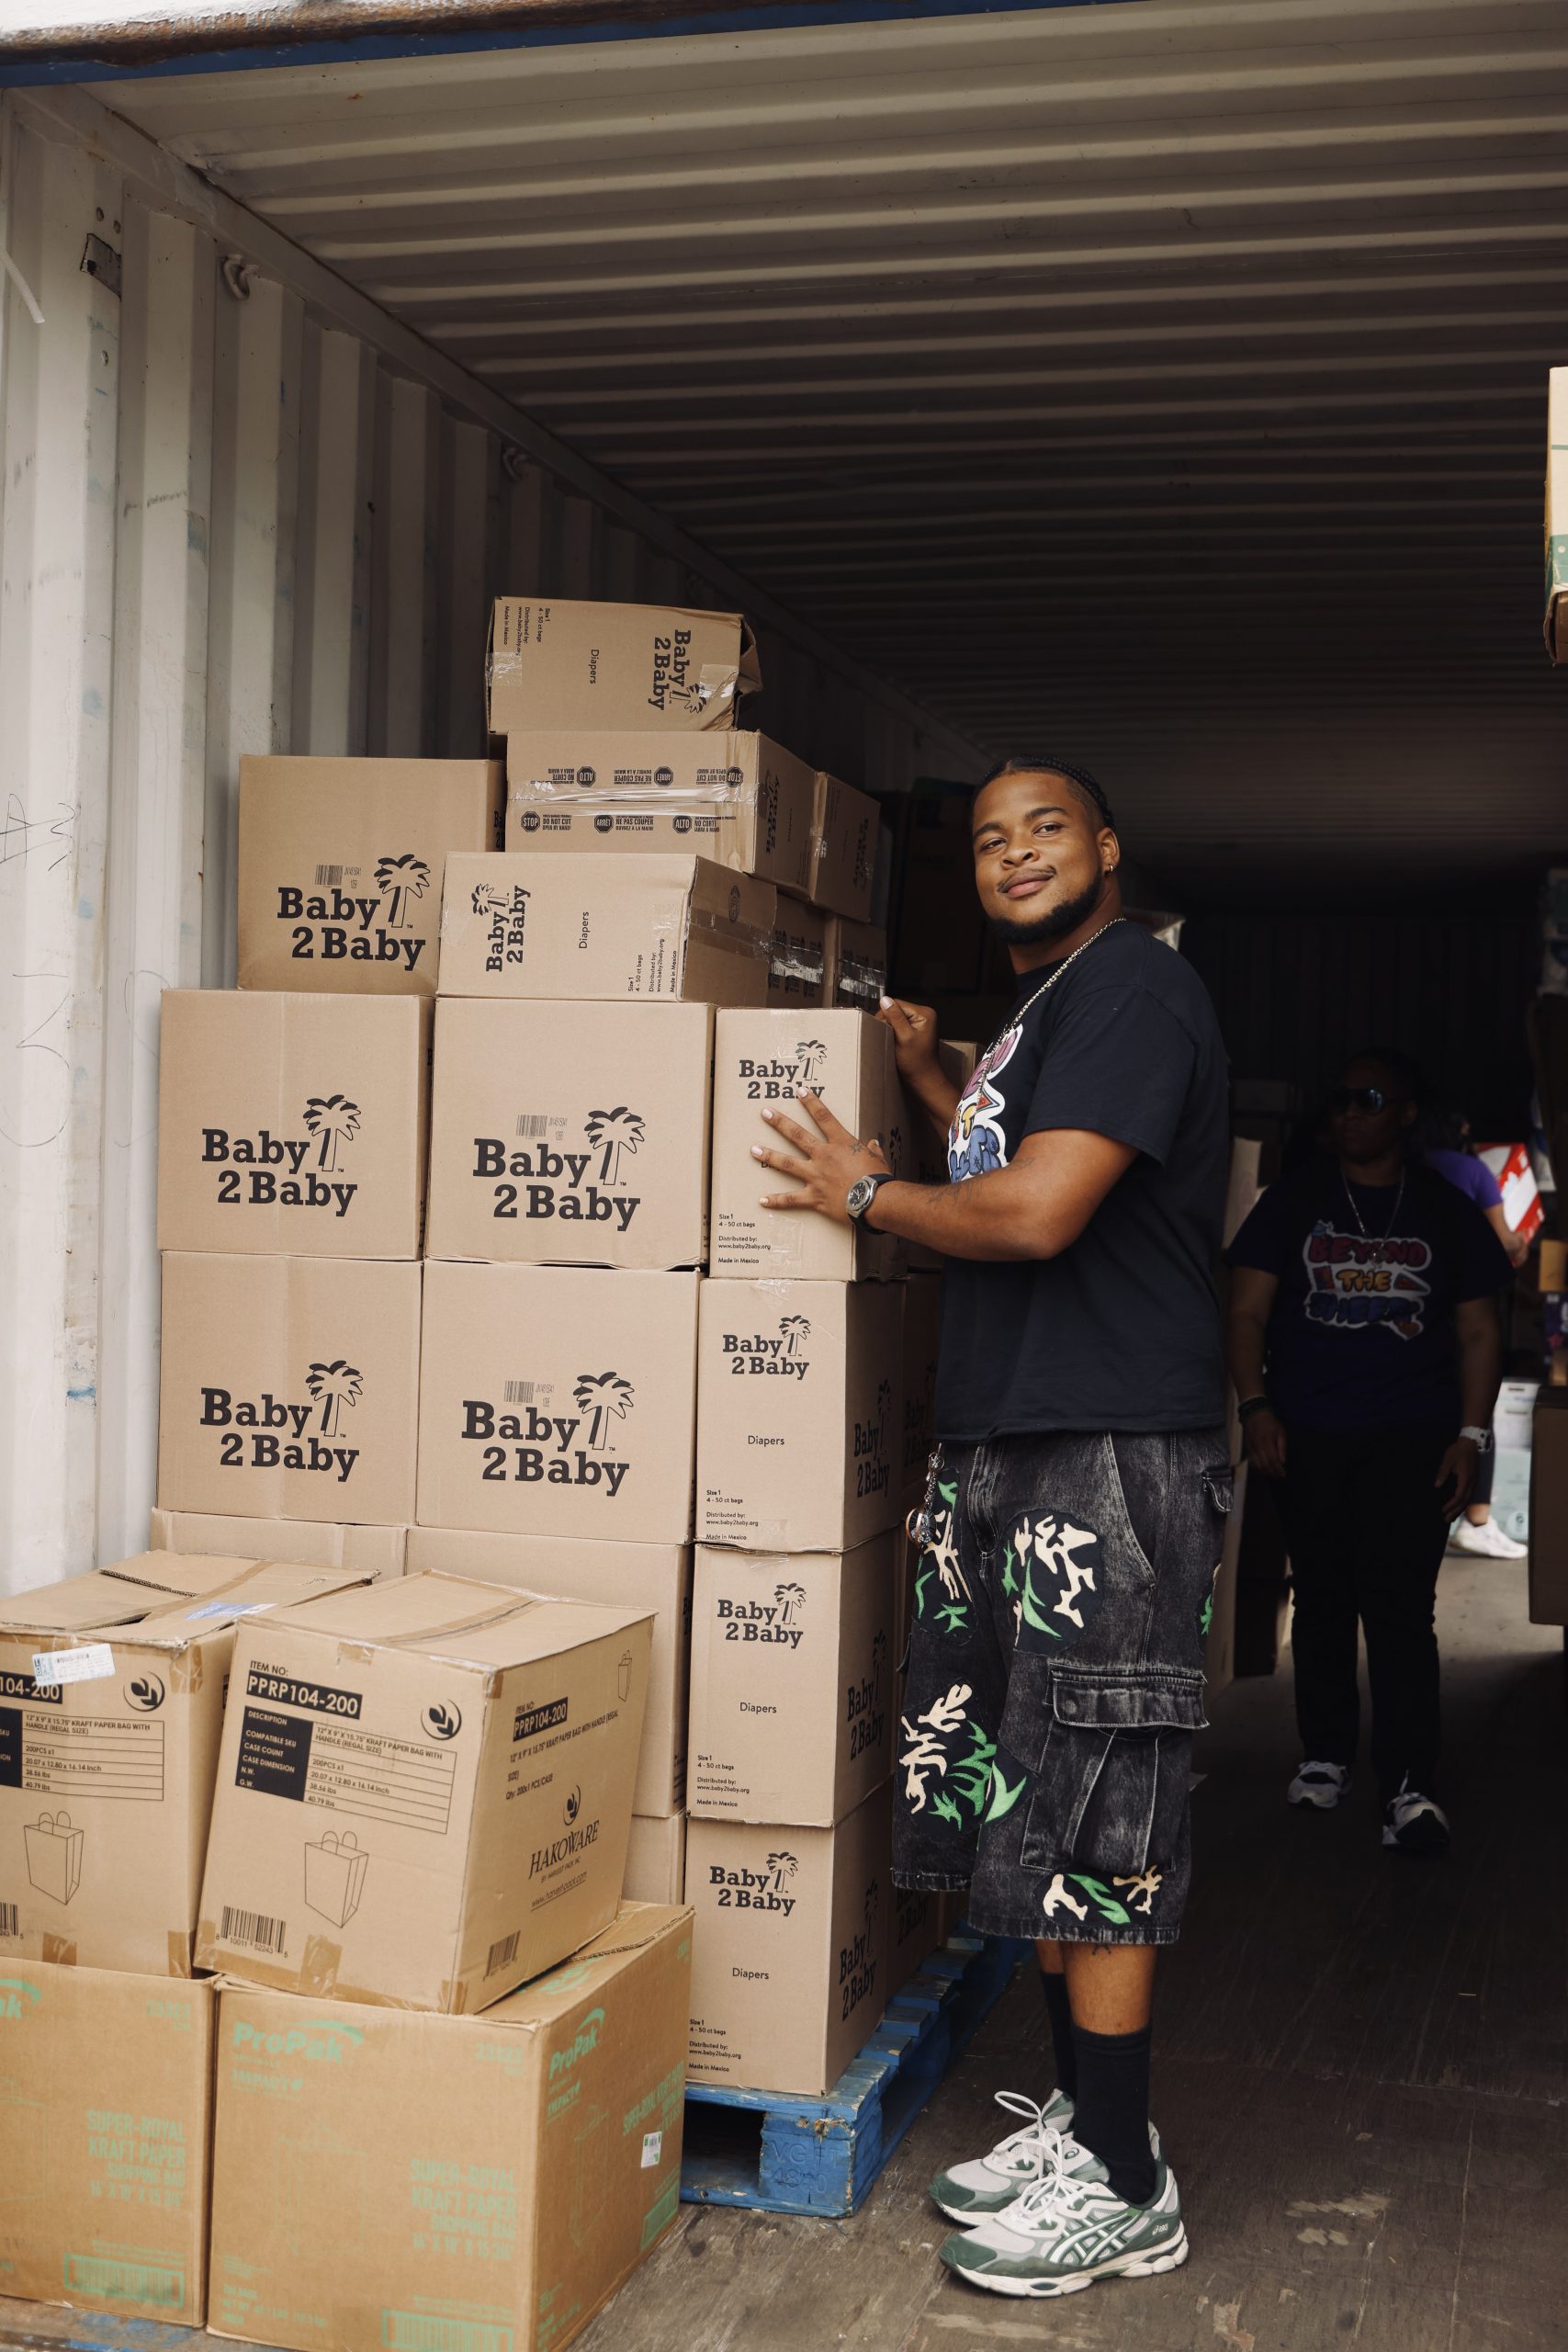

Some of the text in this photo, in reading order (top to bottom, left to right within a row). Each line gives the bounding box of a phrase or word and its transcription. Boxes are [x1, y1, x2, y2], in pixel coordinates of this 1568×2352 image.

[589, 650, 599, 684] Diapers
[670, 629, 692, 687] Baby
[579, 772, 593, 780] ALTO
[523, 818, 538, 827] STOP
[675, 817, 689, 827] ALTO
[276, 887, 380, 930] Baby
[486, 911, 510, 972] Baby
[579, 911, 590, 949] Diapers
[739, 1059, 799, 1082] Baby
[202, 1128, 310, 1175] Baby
[473, 1138, 592, 1189] Baby
[1336, 1269, 1393, 1293] THE
[723, 1334, 783, 1358] Baby
[199, 1387, 312, 1439] Baby
[461, 1400, 581, 1452] Baby
[748, 1435, 785, 1448] Diapers
[853, 1421, 879, 1462] Baby
[716, 1599, 778, 1626] Baby
[250, 1660, 288, 1676] ITEM NO:
[248, 1675, 358, 1714] PPRP104-200
[847, 1677, 875, 1723] Baby
[248, 1711, 287, 1725] DESCRIPTION
[514, 1702, 567, 1738] PPRP104-200
[739, 1702, 777, 1715] Diapers
[26, 1723, 49, 1731] HANDLE
[50, 1724, 71, 1734] (REGAL
[245, 1730, 296, 1747] COMPATIBLE SKU
[244, 1742, 284, 1757] CASE COUNT
[316, 1735, 382, 1756] HANDLE (REGAL SIZE)
[367, 1737, 387, 1747] KRAFT
[389, 1742, 409, 1753] PAPER
[411, 1747, 424, 1756] BAG
[425, 1750, 443, 1759] WITH
[241, 1766, 255, 1775] N.W.
[243, 1755, 295, 1772] CASE DIMENSION
[312, 1758, 335, 1769] 200PCS
[239, 1779, 254, 1788] G.W.
[311, 1771, 327, 1780] 20.07
[358, 1781, 375, 1792] 16.14
[375, 1786, 389, 1794] inch
[696, 1786, 750, 1794] www.baby2baby.org
[308, 1796, 334, 1807] 40.79 lbs
[528, 1820, 600, 1880] HAKOWARE
[709, 1866, 770, 1893] Baby
[839, 1934, 866, 1985] Baby
[732, 1967, 769, 1980] Diapers
[234, 2021, 343, 2064] ProPak
[549, 2026, 596, 2081] ProPak
[689, 2041, 718, 2049] Distributed
[689, 2049, 741, 2060] www.baby2baby.org
[89, 2135, 185, 2168] KRAFT PAPER
[412, 2158, 514, 2193] SUPER-ROYAL
[412, 2185, 515, 2220] KRAFT PAPER
